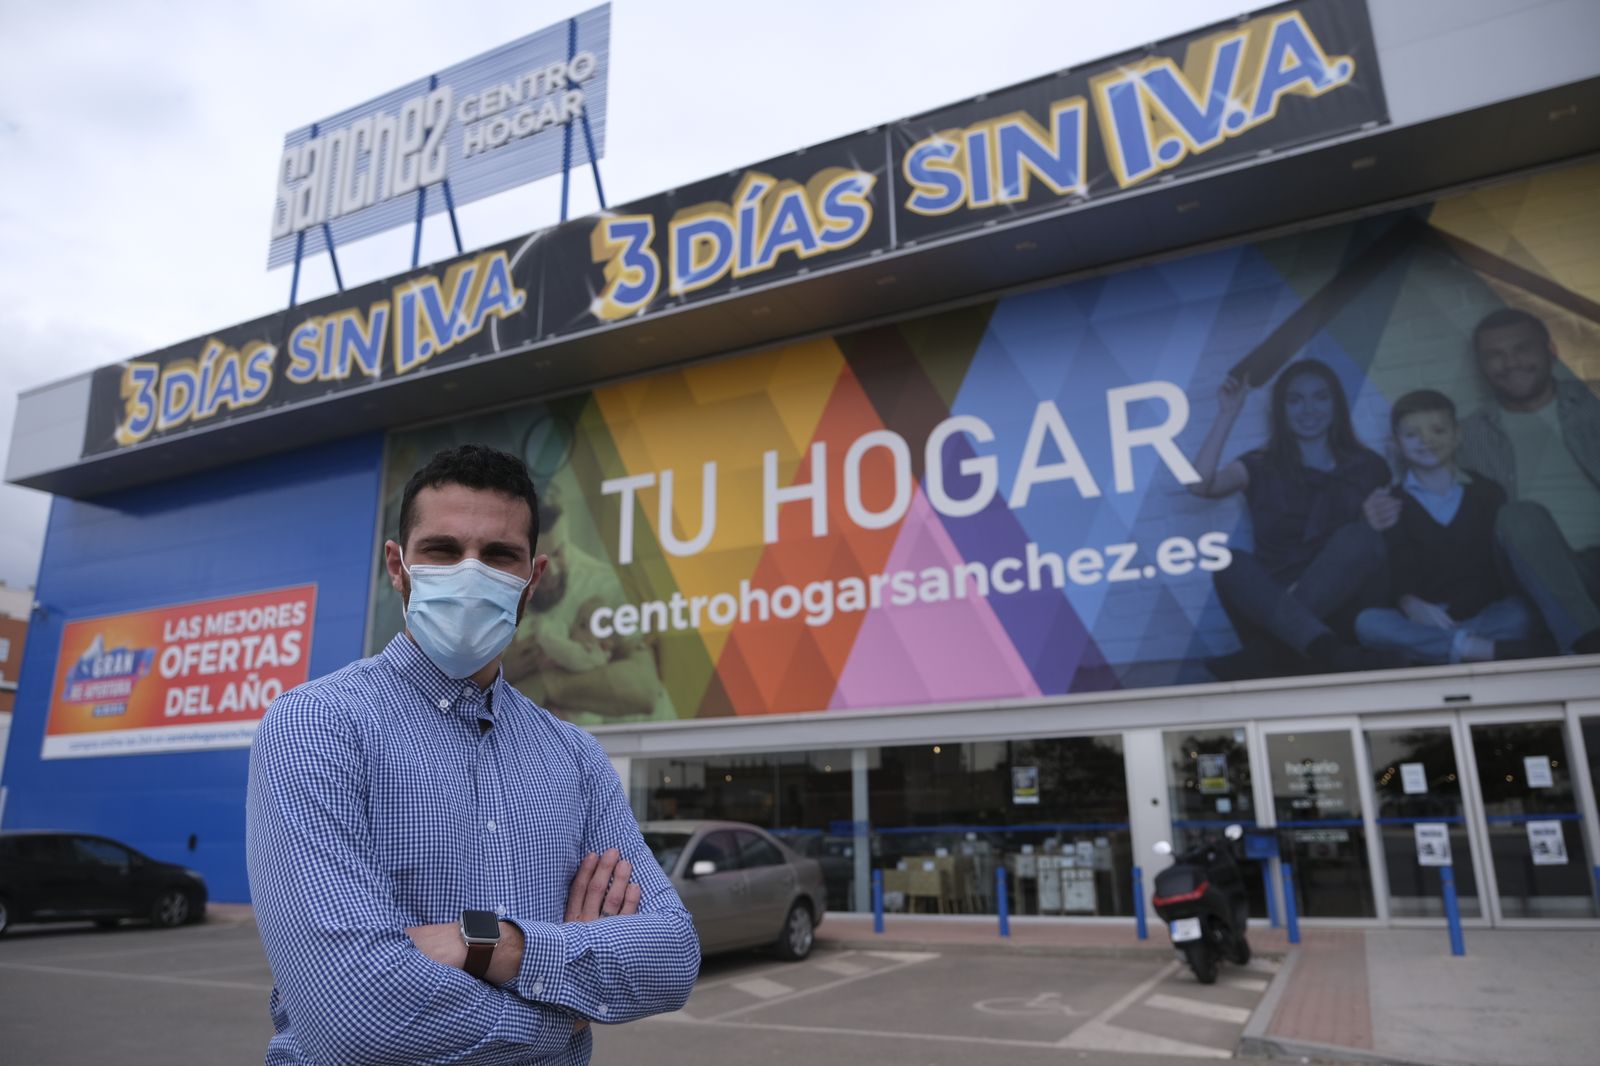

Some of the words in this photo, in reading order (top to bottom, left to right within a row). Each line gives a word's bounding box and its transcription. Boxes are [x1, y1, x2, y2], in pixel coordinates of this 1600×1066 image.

[458, 52, 596, 125] CENTRO
[463, 90, 586, 158] HOGAR
[595, 215, 659, 320] 3
[668, 171, 877, 295] DÍAS
[905, 99, 1087, 215] SIN
[1091, 10, 1355, 188] I.V.A.
[121, 361, 158, 441] 3
[157, 342, 276, 428] DÍAS
[287, 305, 389, 383] SIN
[395, 252, 526, 372] I.V.A.
[601, 461, 717, 565] TU
[762, 381, 1203, 544] HOGAR
[163, 617, 202, 643] LAS
[203, 601, 307, 637] MEJORES
[590, 531, 1232, 640] centrohogarsanchez.es
[159, 630, 302, 679] OFERTAS
[164, 684, 216, 718] DEL
